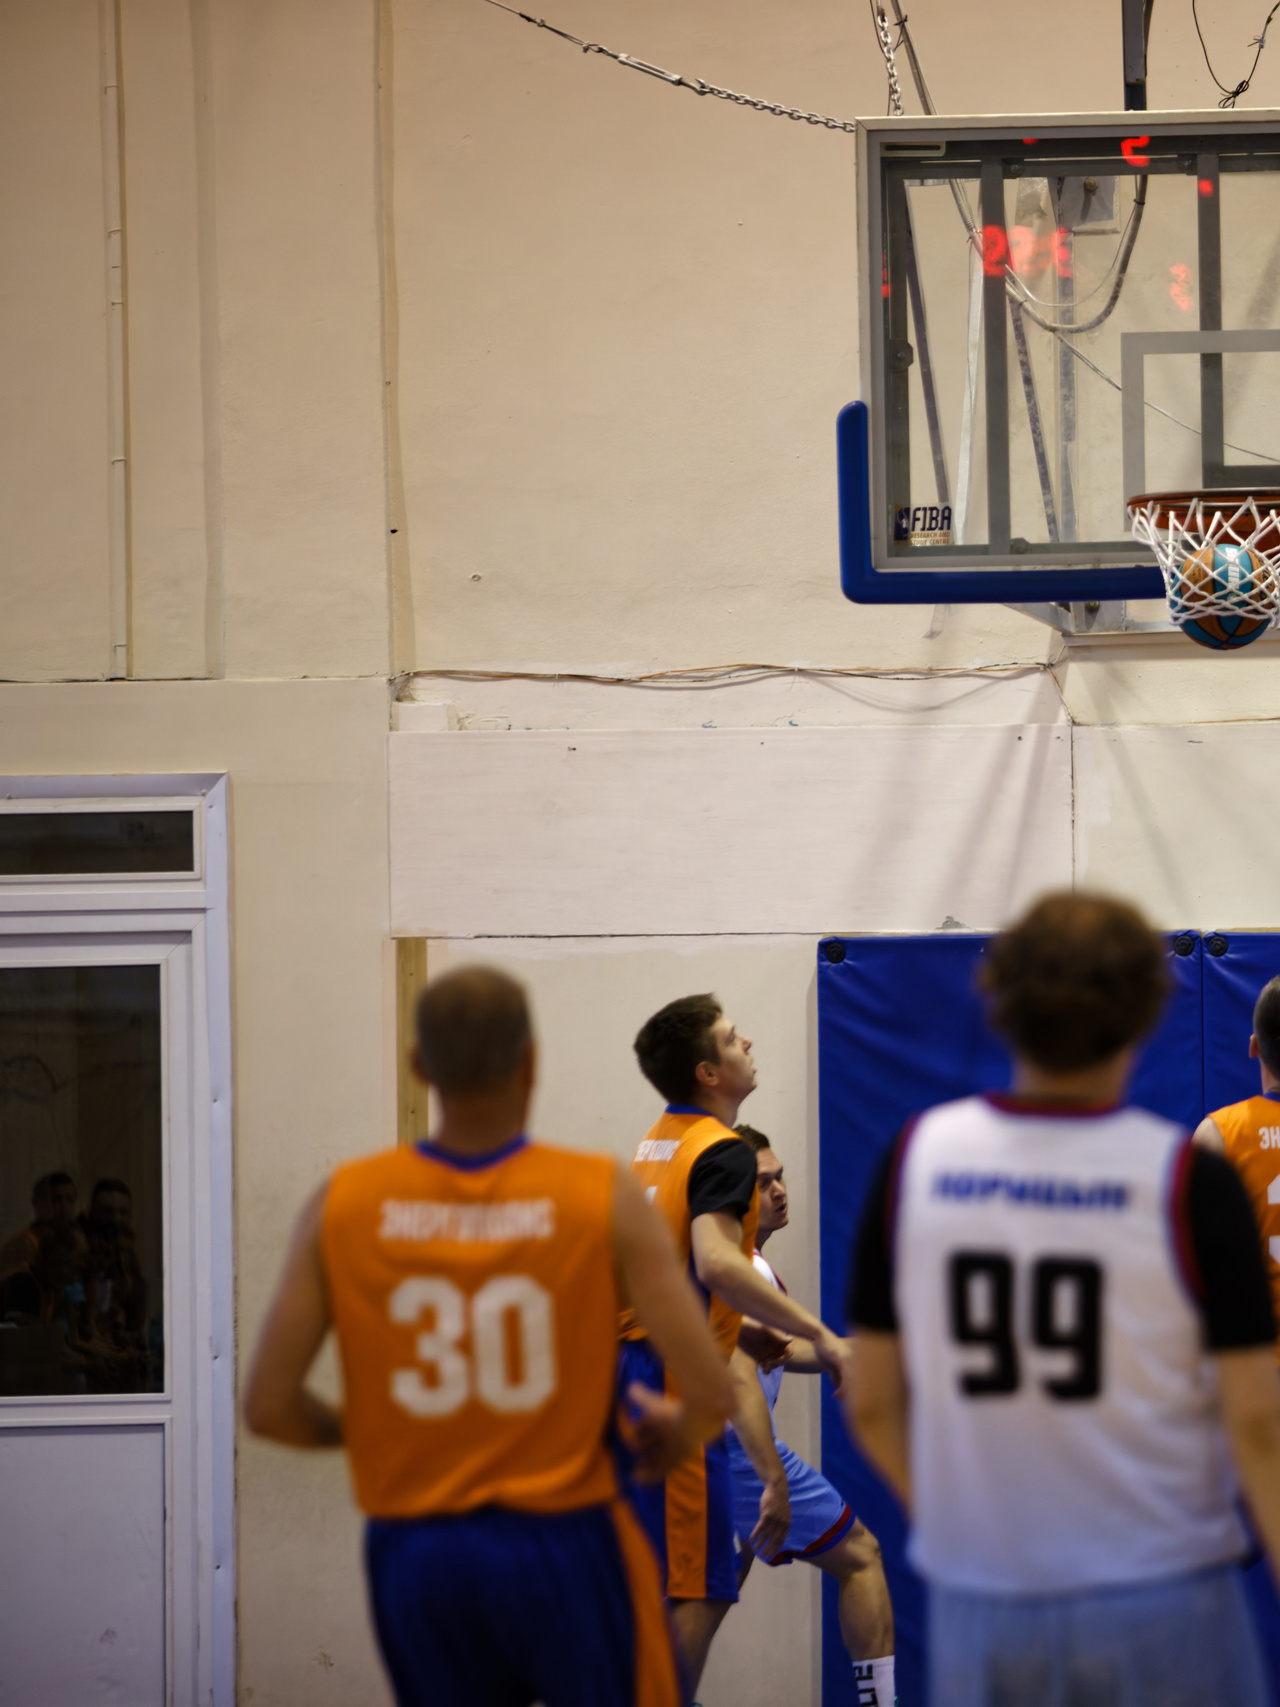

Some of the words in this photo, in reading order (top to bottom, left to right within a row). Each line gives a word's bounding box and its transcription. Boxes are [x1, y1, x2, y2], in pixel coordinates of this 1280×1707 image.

[911, 506, 952, 531] FIBA
[389, 1275, 556, 1418] 30
[947, 1250, 1105, 1403] 99
